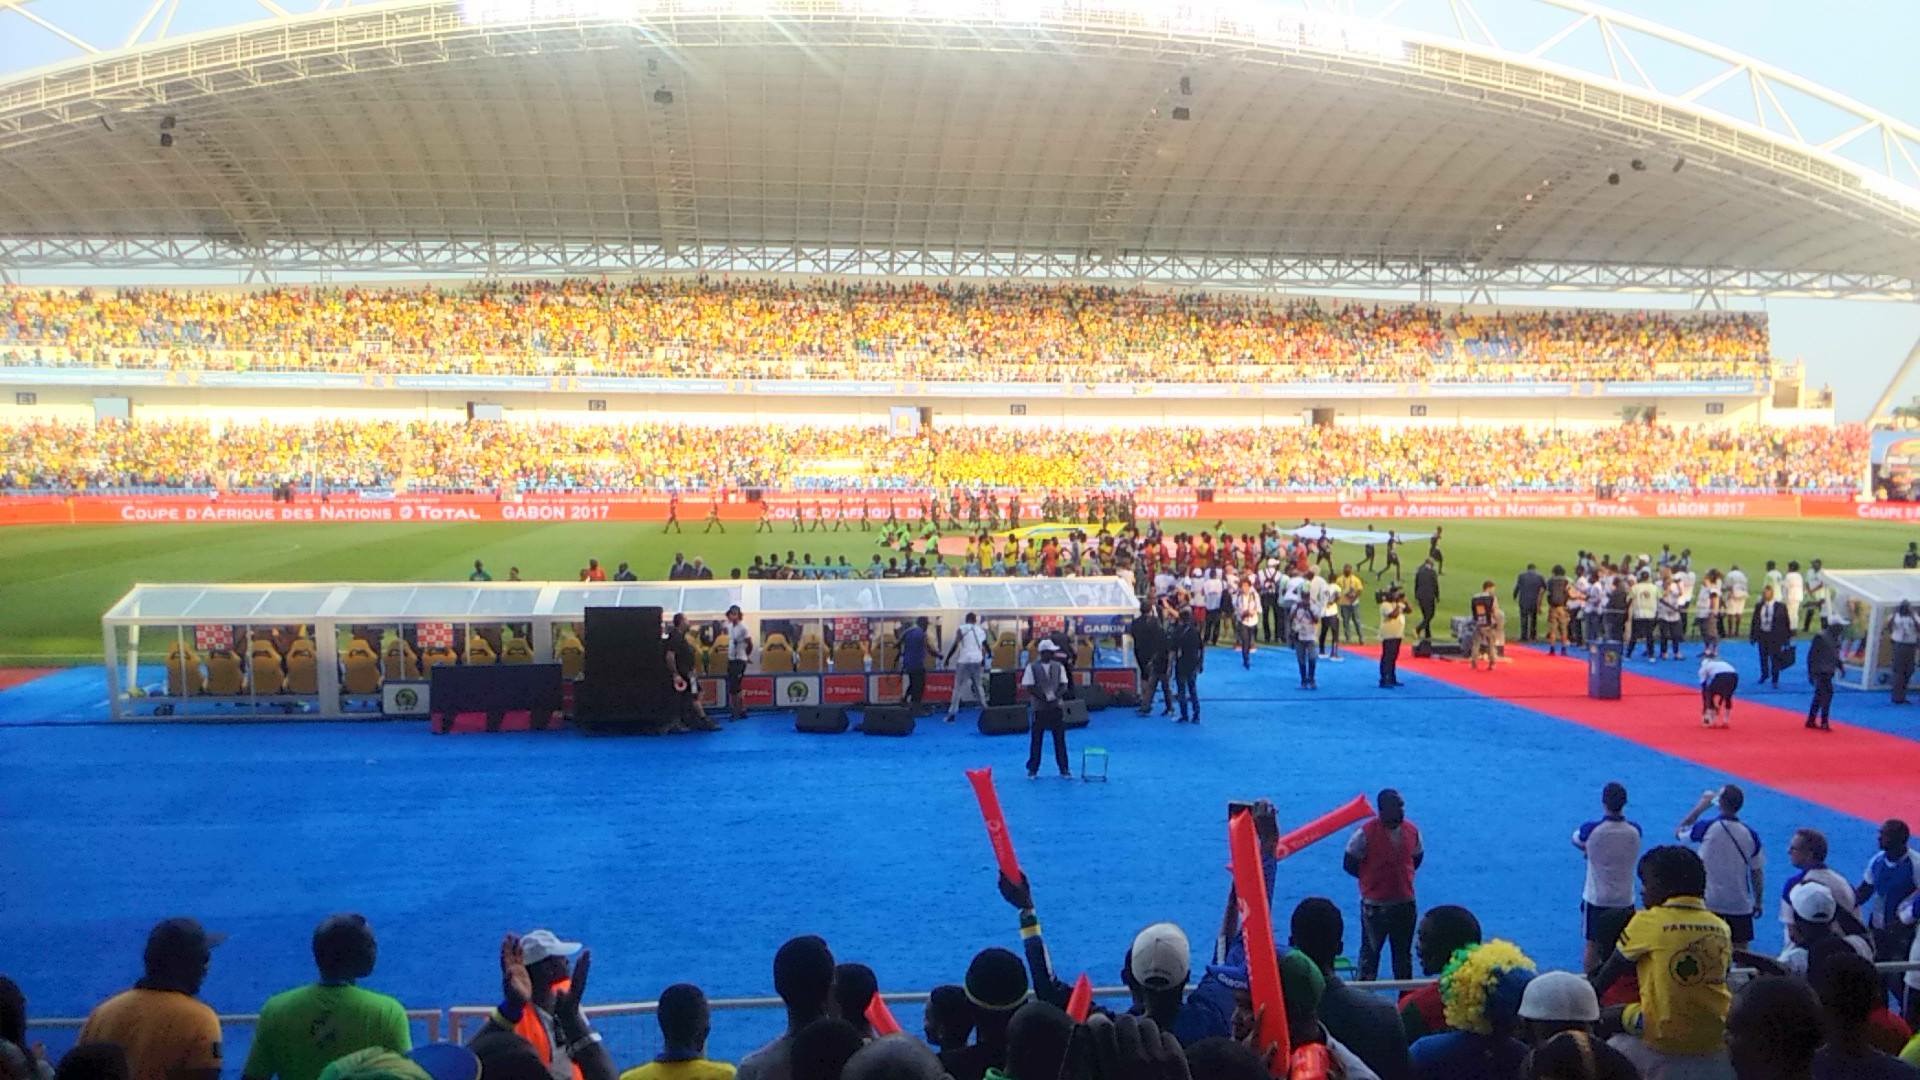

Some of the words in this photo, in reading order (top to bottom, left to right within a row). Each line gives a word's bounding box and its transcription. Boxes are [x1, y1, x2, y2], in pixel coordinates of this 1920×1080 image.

[121, 506, 179, 520] COUPE
[186, 506, 275, 520] D'AFRIQUE
[282, 507, 313, 520] DES
[320, 506, 392, 520] NATIONS
[418, 505, 481, 520] TOTAL
[502, 505, 565, 520] GABON
[571, 505, 609, 519] 2017
[1163, 504, 1199, 518] 2017
[1340, 504, 1388, 517] COUPE
[1393, 504, 1470, 518] D'AFRIQUE
[1474, 505, 1501, 517] DES
[1506, 503, 1565, 517] NATIONS
[1589, 503, 1638, 516] TOTAL
[1656, 502, 1708, 515] GABON
[1713, 502, 1745, 515] 2017
[1083, 624, 1126, 633] GABON
[834, 686, 863, 694] TOTAL
